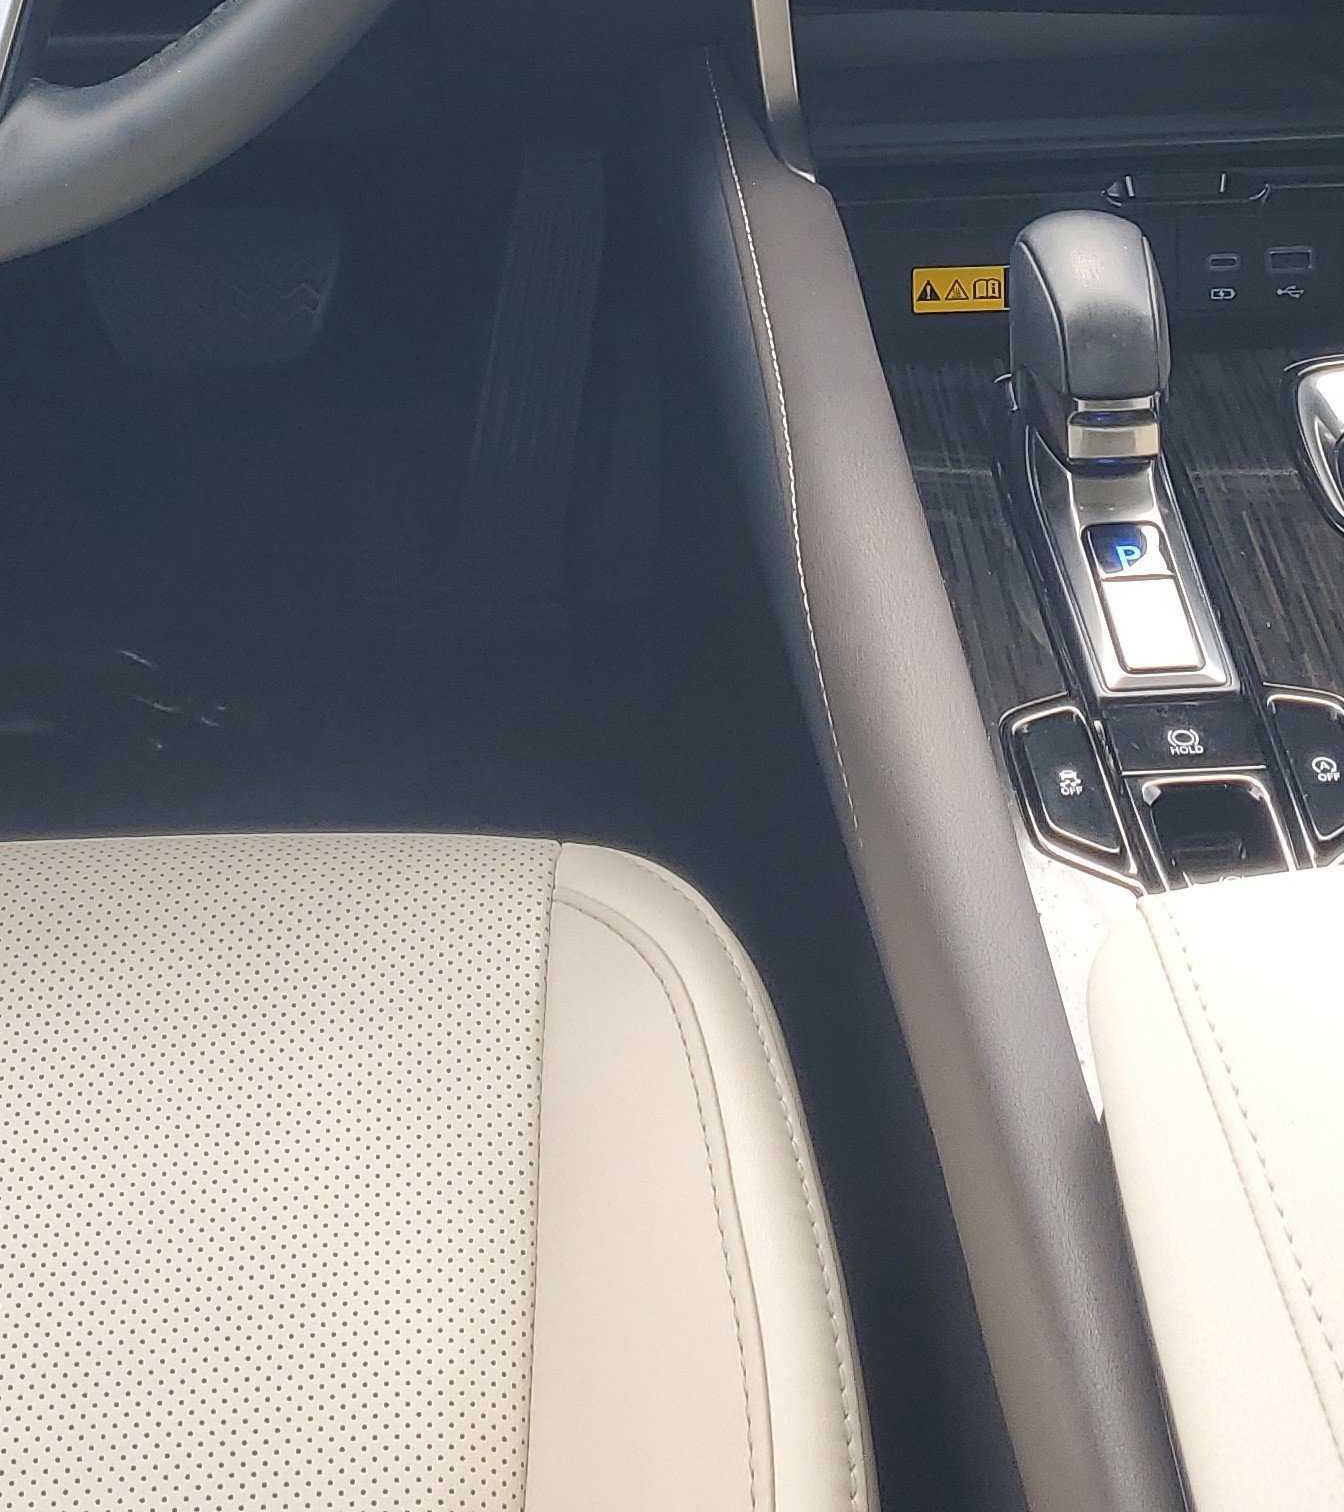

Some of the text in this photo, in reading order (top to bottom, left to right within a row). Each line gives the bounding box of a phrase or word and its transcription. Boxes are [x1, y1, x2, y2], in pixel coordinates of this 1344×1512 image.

[1116, 545, 1142, 570] P
[1170, 744, 1204, 756] HOLD
[1317, 771, 1340, 782] OFF
[1060, 786, 1083, 796] OFF
